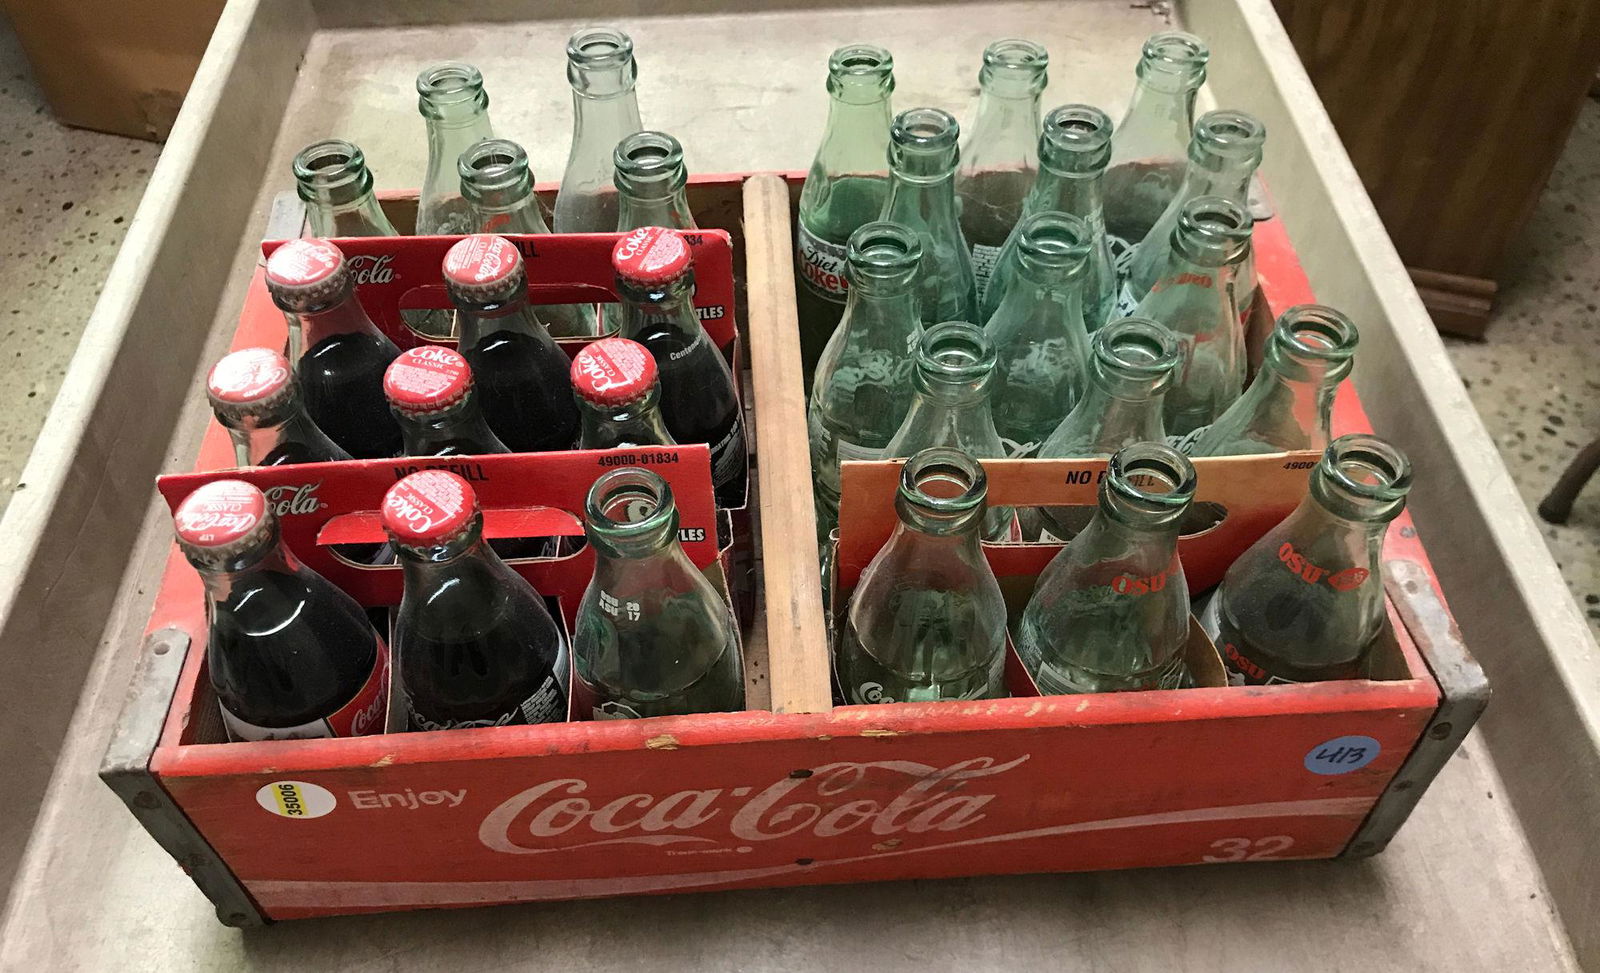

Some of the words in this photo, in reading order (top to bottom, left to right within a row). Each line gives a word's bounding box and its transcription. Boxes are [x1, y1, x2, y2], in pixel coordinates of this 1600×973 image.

[807, 246, 838, 272] Diet
[408, 346, 459, 366] Coke
[578, 353, 612, 392] Coke
[1065, 470, 1092, 485] NO
[387, 495, 432, 534] Coke
[1278, 542, 1324, 585] OSU
[1111, 569, 1167, 596] OSU
[628, 612, 641, 621] 17
[278, 784, 304, 816] 35006
[347, 788, 468, 810] Enjoy
[1202, 835, 1295, 863] 32
